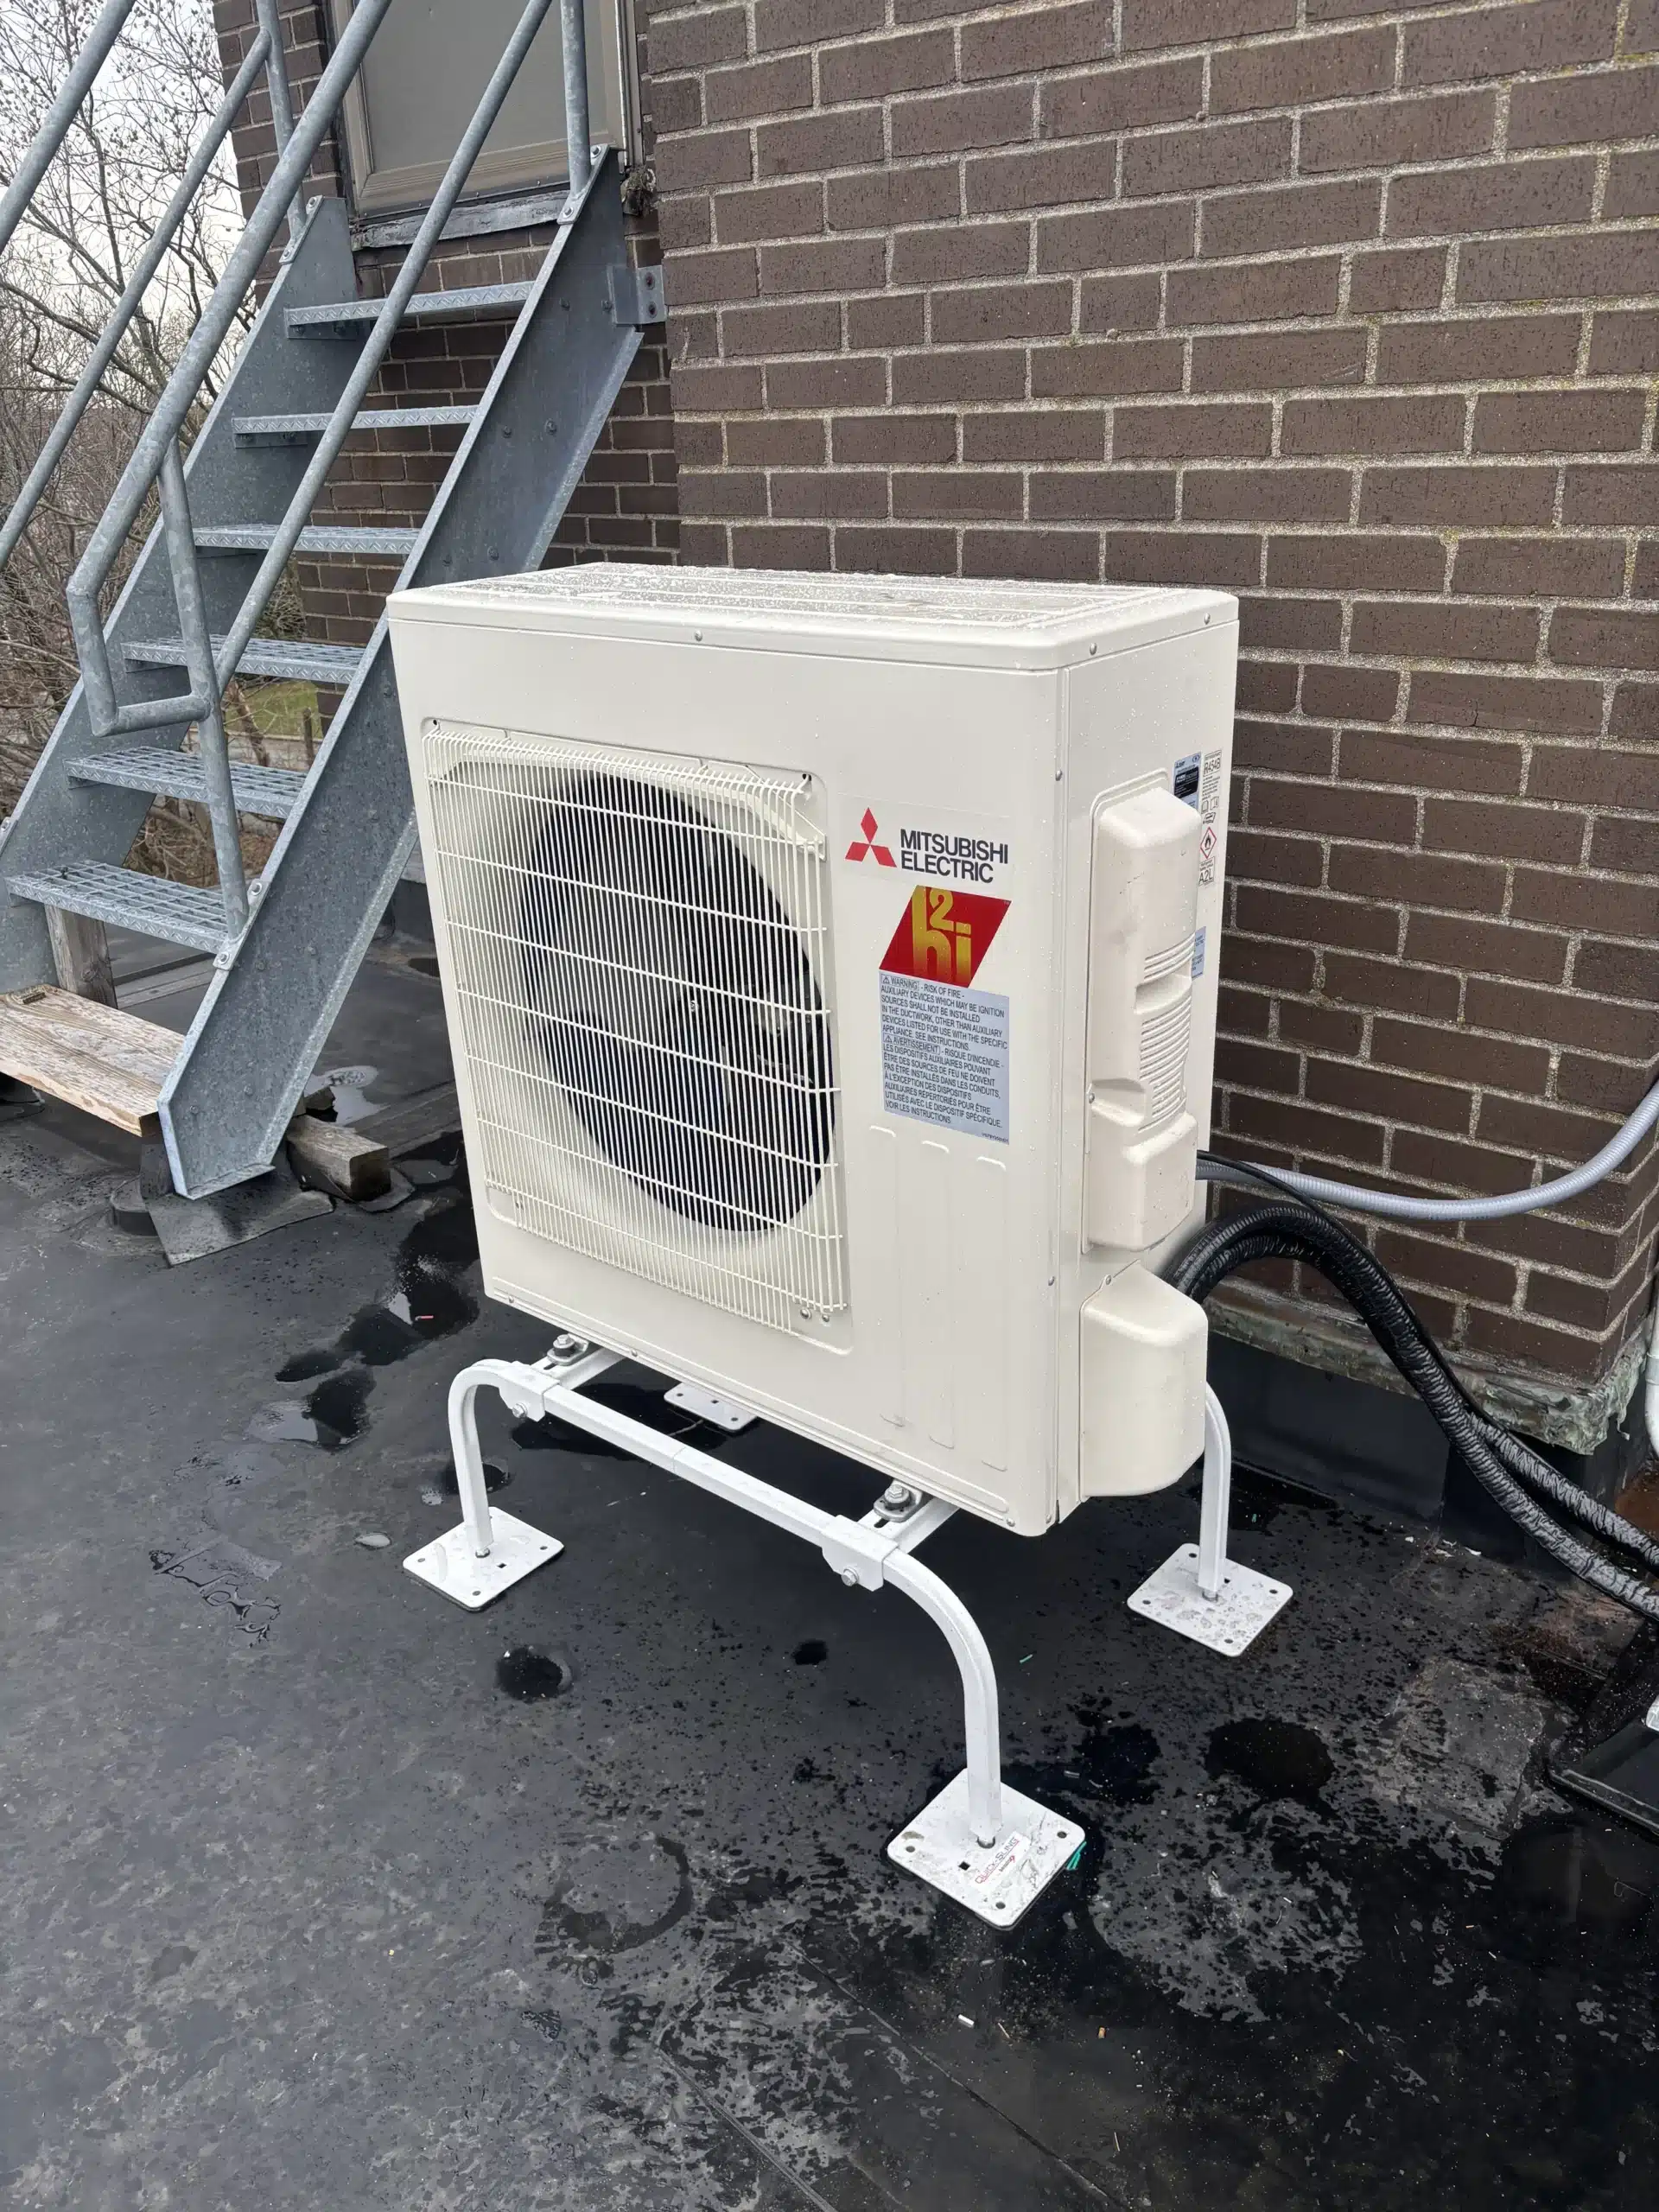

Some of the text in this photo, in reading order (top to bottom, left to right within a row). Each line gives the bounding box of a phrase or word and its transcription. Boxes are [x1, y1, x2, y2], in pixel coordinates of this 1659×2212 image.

[900, 829, 1008, 864] MITSUBISHI
[901, 850, 994, 883] ELECTRIC
[1198, 868, 1214, 886] A2L
[880, 984, 1004, 1018] AUXILIARY DEVICES WHICH MAY BE IGNITION
[891, 976, 917, 989] WARNING
[924, 983, 937, 994] RISK
[938, 987, 946, 995] OF
[947, 988, 961, 998] FIRE
[881, 995, 979, 1022] SOURCES SHALL NOT BE INSTALLED
[888, 1006, 899, 1014] THE
[935, 1015, 954, 1027] OTHER
[957, 1020, 970, 1031] THAN
[972, 1024, 1001, 1038] AUXILIARY
[882, 1014, 1007, 1049] DEVICES LISTED FOR USE WITH THE SPECIFIC
[915, 1031, 925, 1040] SEE
[883, 1043, 893, 1052] LES
[894, 1046, 927, 1060] DISPOSITIFS
[963, 1062, 990, 1076] POUVANT
[893, 1035, 938, 1053] AVERTISSEMENT
[944, 1047, 965, 1059] RISQUE
[884, 1061, 893, 1071] PAS
[940, 1076, 955, 1087] DANS
[957, 1080, 968, 1090] LES
[899, 1056, 910, 1065] DES
[911, 1058, 938, 1072] SOURCES
[939, 1065, 946, 1075] DE
[948, 1068, 958, 1077] FEU
[960, 1071, 968, 1080] NE
[969, 1073, 995, 1087] DOIVENT
[925, 1081, 935, 1090] DES
[937, 1084, 971, 1100] DISPOSITIFS
[957, 1099, 974, 1110] POUR
[886, 1099, 898, 1109] VOIR
[899, 1103, 909, 1112] LES
[910, 1096, 924, 1107] AVEC
[925, 1100, 931, 1109] LE
[933, 1103, 963, 1118] DISPOSITIF
[975, 1837, 1020, 1884] QUICK-SLING
